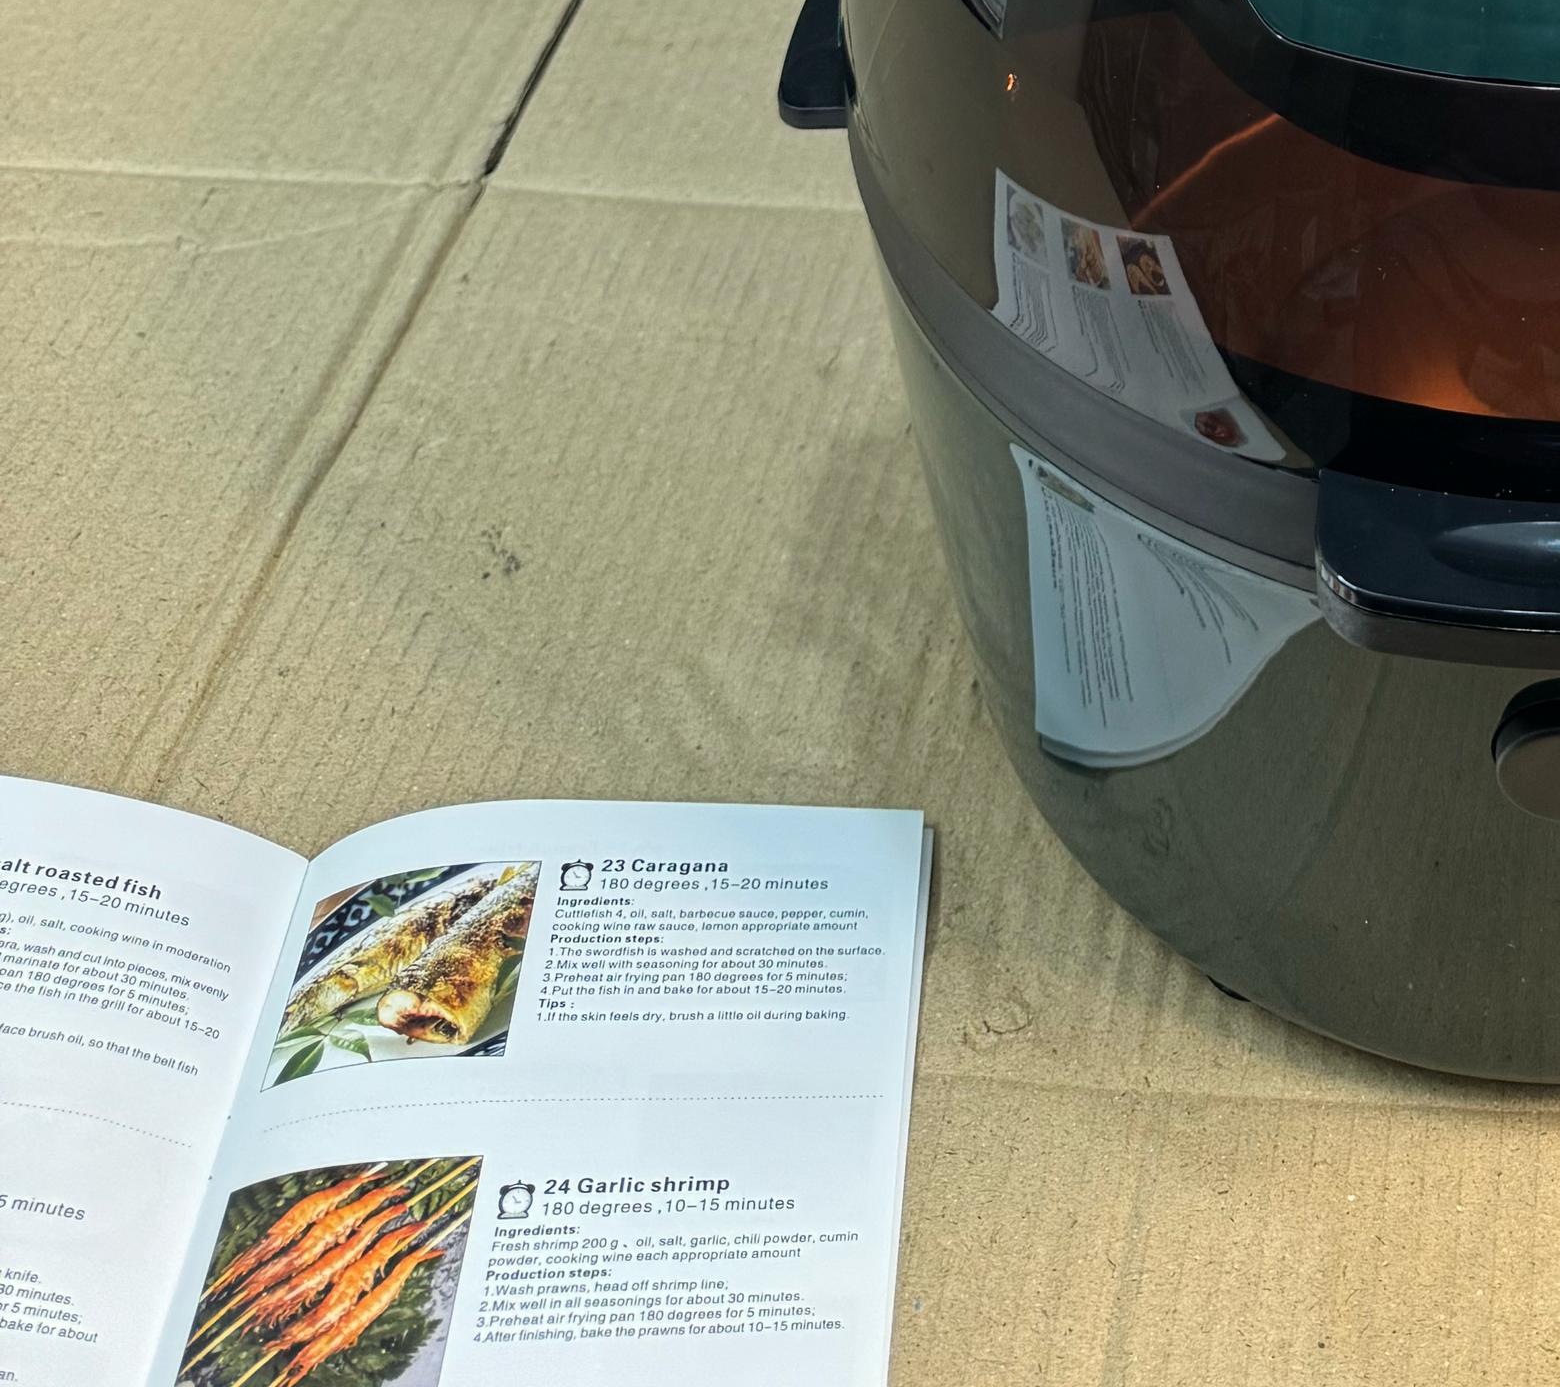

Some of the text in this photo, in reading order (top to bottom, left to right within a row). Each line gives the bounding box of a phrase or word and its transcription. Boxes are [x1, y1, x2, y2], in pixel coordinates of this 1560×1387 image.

[601, 858, 728, 875] 23 Caragana
[36, 865, 120, 891] roasted
[123, 879, 163, 901] fish
[599, 877, 828, 893] 180 degrees ,15-20 minutes
[0, 880, 58, 898] egrees
[125, 901, 191, 928] minutes
[556, 896, 634, 907] Ingredients:
[40, 916, 67, 931] salt,
[70, 922, 119, 942] cooking
[121, 934, 150, 949] wine
[152, 938, 163, 950] in
[166, 945, 232, 974] moderation
[550, 933, 664, 945] Production steps:
[544, 959, 828, 972] 2.Mix well with seasoning for about 30 minutes.
[538, 998, 566, 1010] Tips
[537, 1010, 850, 1023] 1.If the skin feels dry, brush a little oil during baking.
[543, 1176, 729, 1195] 24 Garlic shrimp
[11, 1196, 86, 1222] minutes
[543, 1197, 795, 1217] 180 degrees ,10-15 minutes
[494, 1225, 580, 1239] Ingredients:
[5, 1268, 43, 1284] knife.
[485, 1267, 612, 1281] Production steps:
[484, 1278, 728, 1297] 1.Wash prawns, head off shrimp line;
[15, 1288, 75, 1306] minutes.
